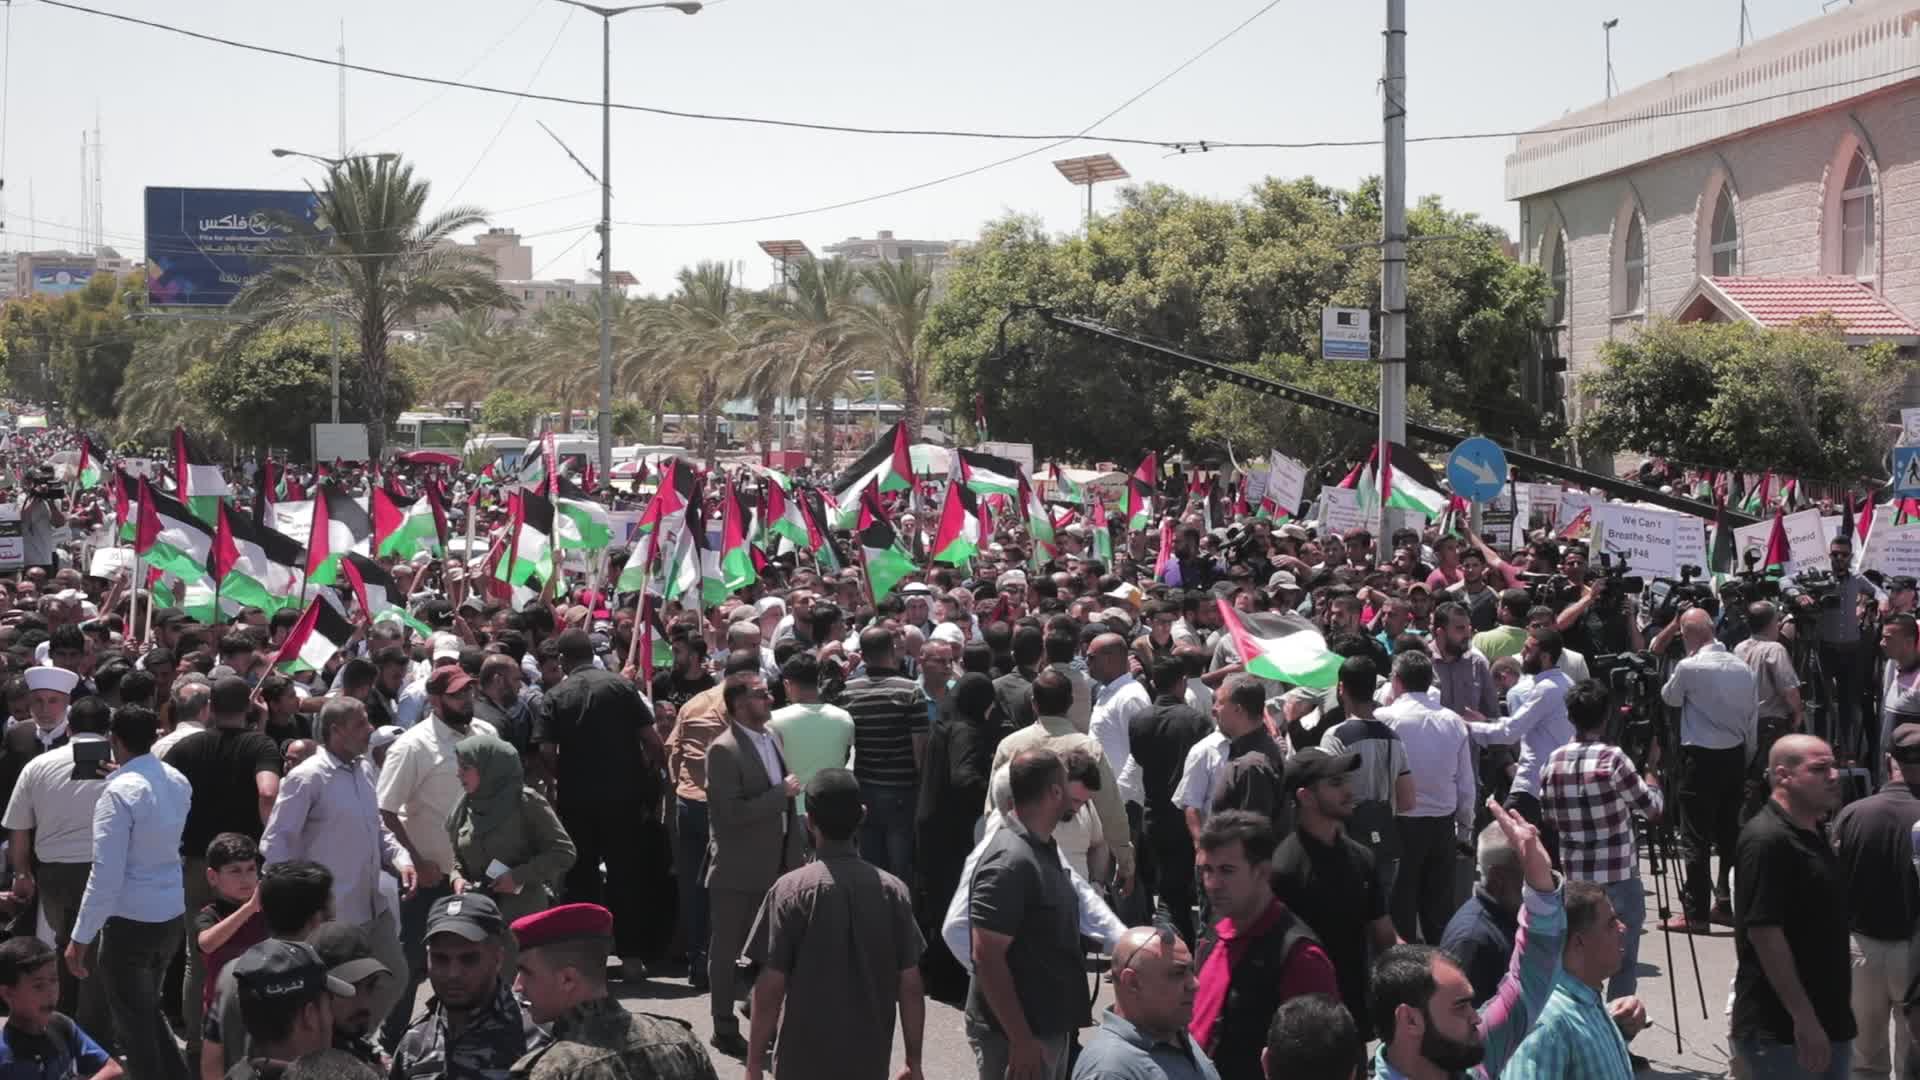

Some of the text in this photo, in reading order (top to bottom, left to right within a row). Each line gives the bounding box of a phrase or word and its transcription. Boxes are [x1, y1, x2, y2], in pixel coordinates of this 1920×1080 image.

[199, 213, 248, 231] فلكس
[1621, 515, 1662, 529] We Can't
[1608, 528, 1671, 546] Breathe Since
[1628, 547, 1650, 559] 1948
